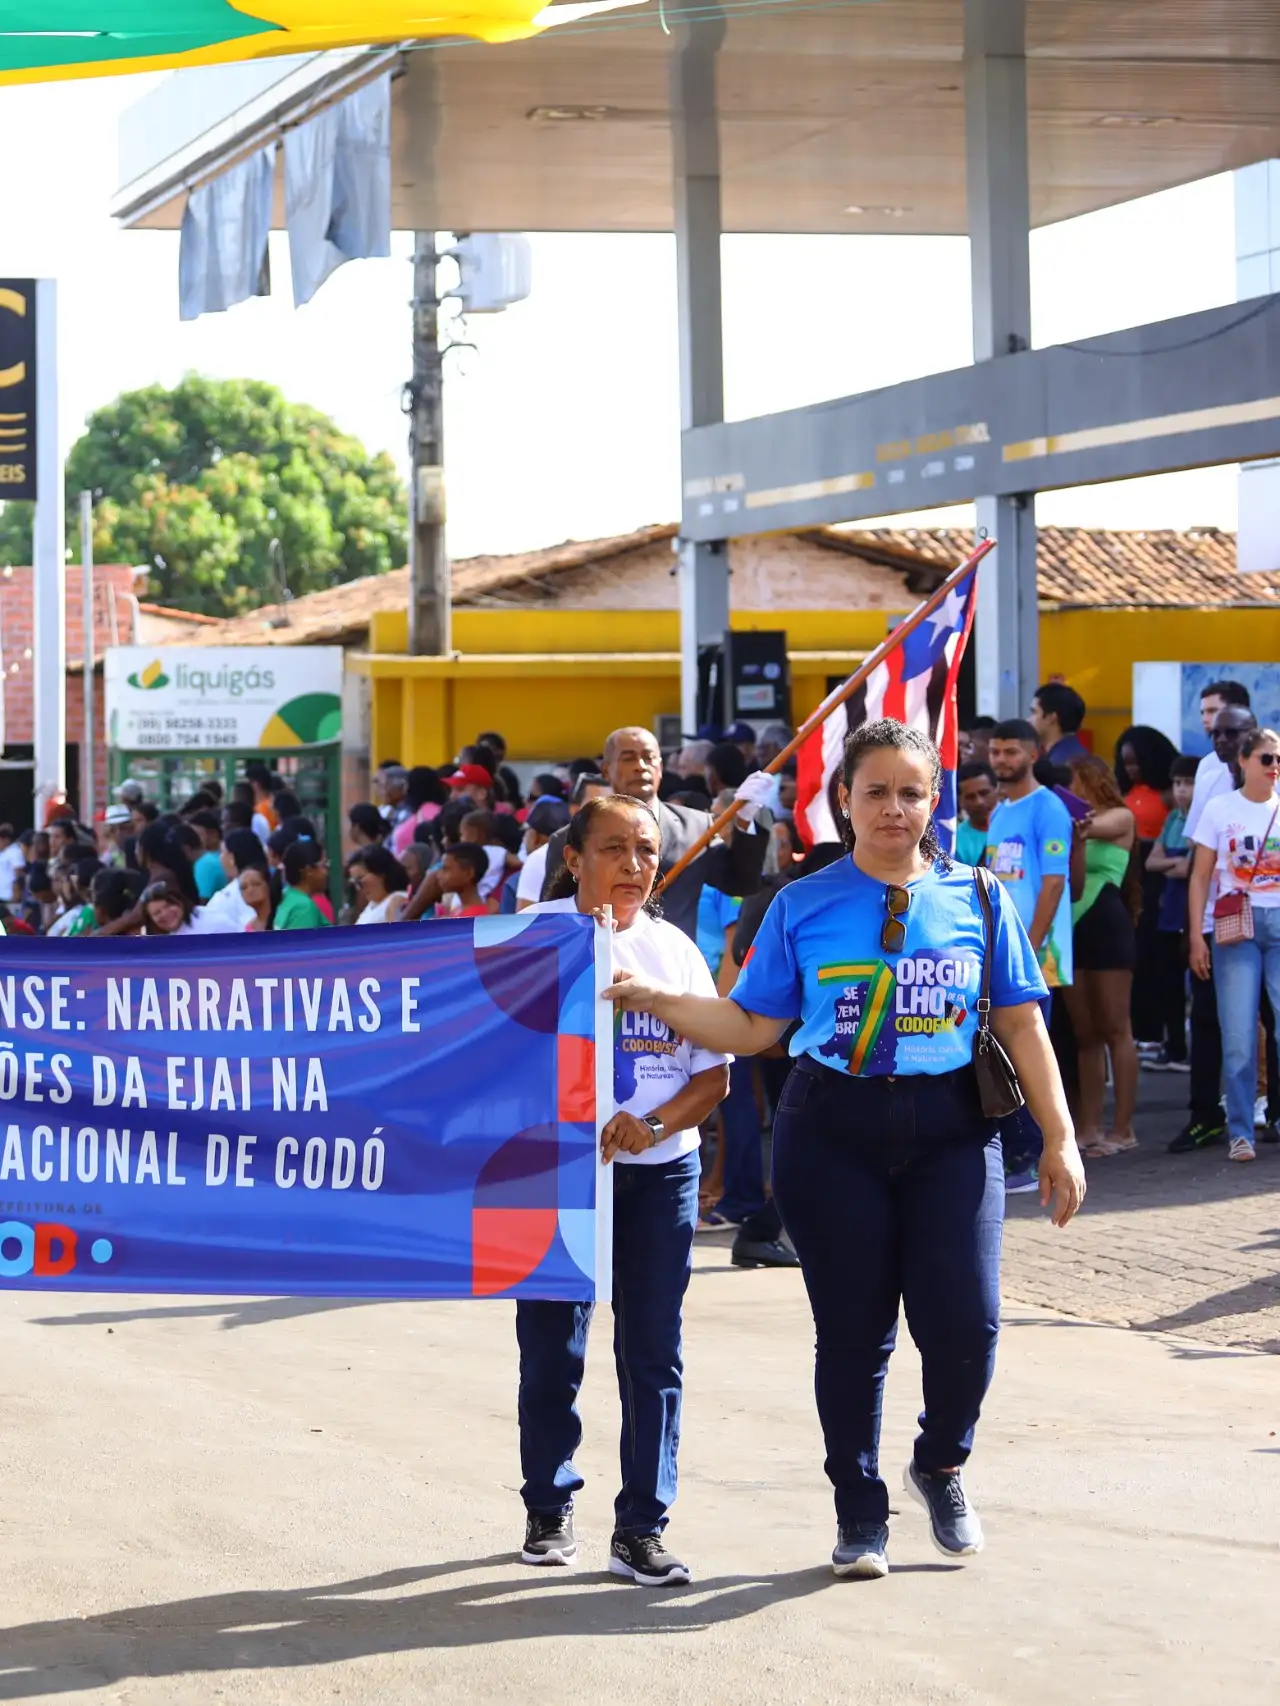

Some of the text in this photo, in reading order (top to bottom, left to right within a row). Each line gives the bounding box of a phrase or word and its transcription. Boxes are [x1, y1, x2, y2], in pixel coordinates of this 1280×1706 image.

[176, 664, 276, 696] liquigás
[896, 958, 970, 990] ORGU
[106, 976, 381, 1034] NARRATIVAS
[401, 977, 422, 1034] E
[843, 987, 859, 1000] SE
[895, 986, 947, 1016] LHO
[837, 1004, 861, 1019] TEM
[92, 1055, 149, 1110] DA
[166, 1056, 251, 1113] EJAI
[271, 1057, 328, 1113] NA
[205, 1134, 257, 1187] DE
[275, 1126, 386, 1191] CODÓ
[82, 1203, 103, 1215] DE
